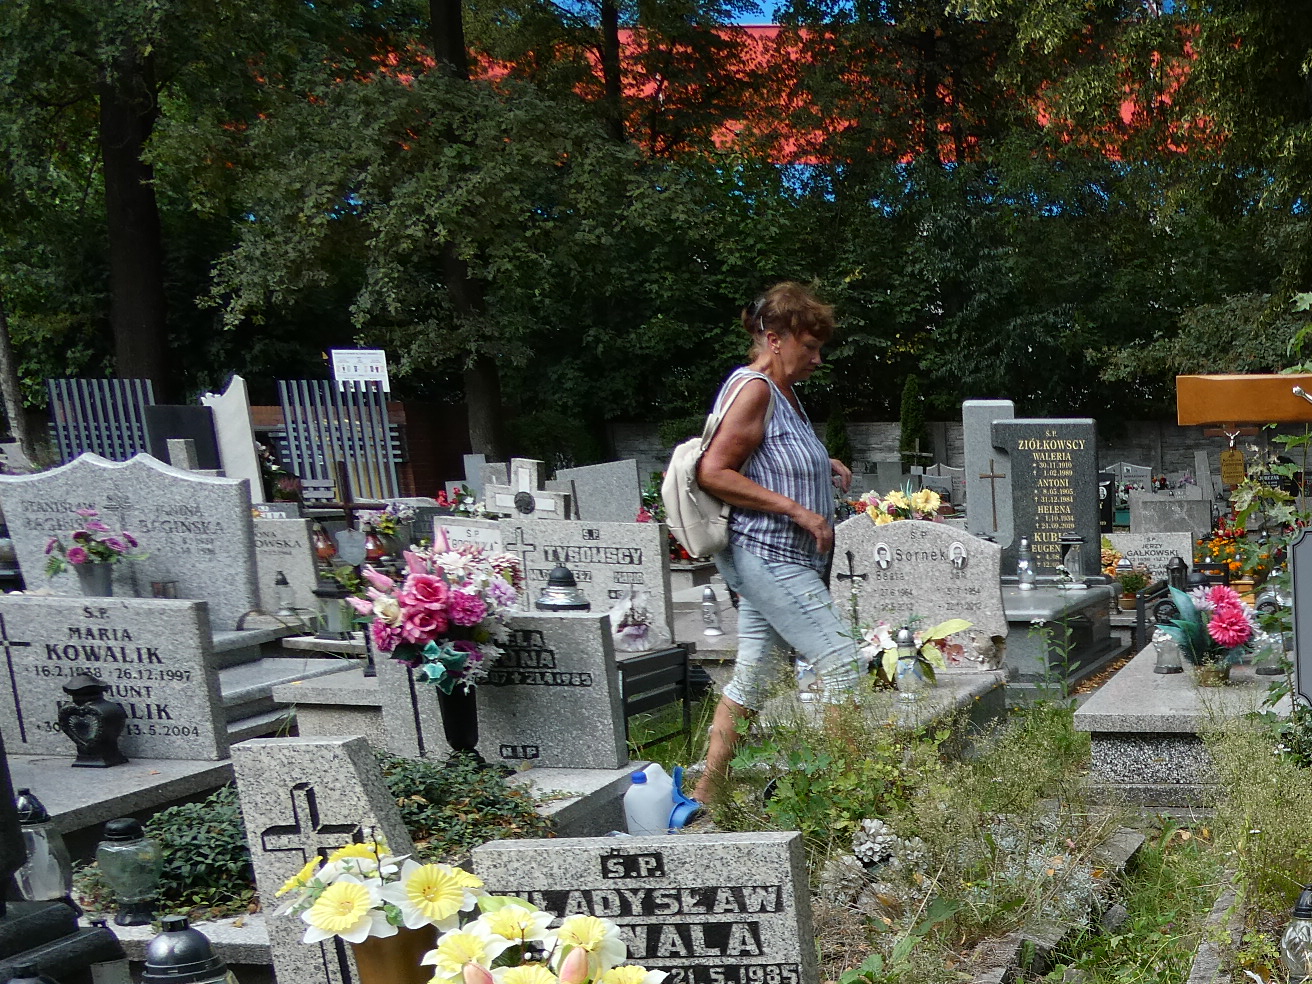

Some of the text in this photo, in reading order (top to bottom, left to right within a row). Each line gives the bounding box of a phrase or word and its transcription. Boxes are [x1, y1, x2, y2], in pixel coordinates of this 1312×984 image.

[1018, 438, 1086, 450] ZIÓŁKOWSCY
[1032, 452, 1072, 461] WALERIA
[1037, 479, 1069, 487] ANTONI
[1037, 506, 1072, 514] HELENA
[895, 548, 946, 562] Sornek
[68, 627, 133, 642] MARIA
[45, 643, 165, 665] KOWALIK
[103, 684, 153, 699] MUNT
